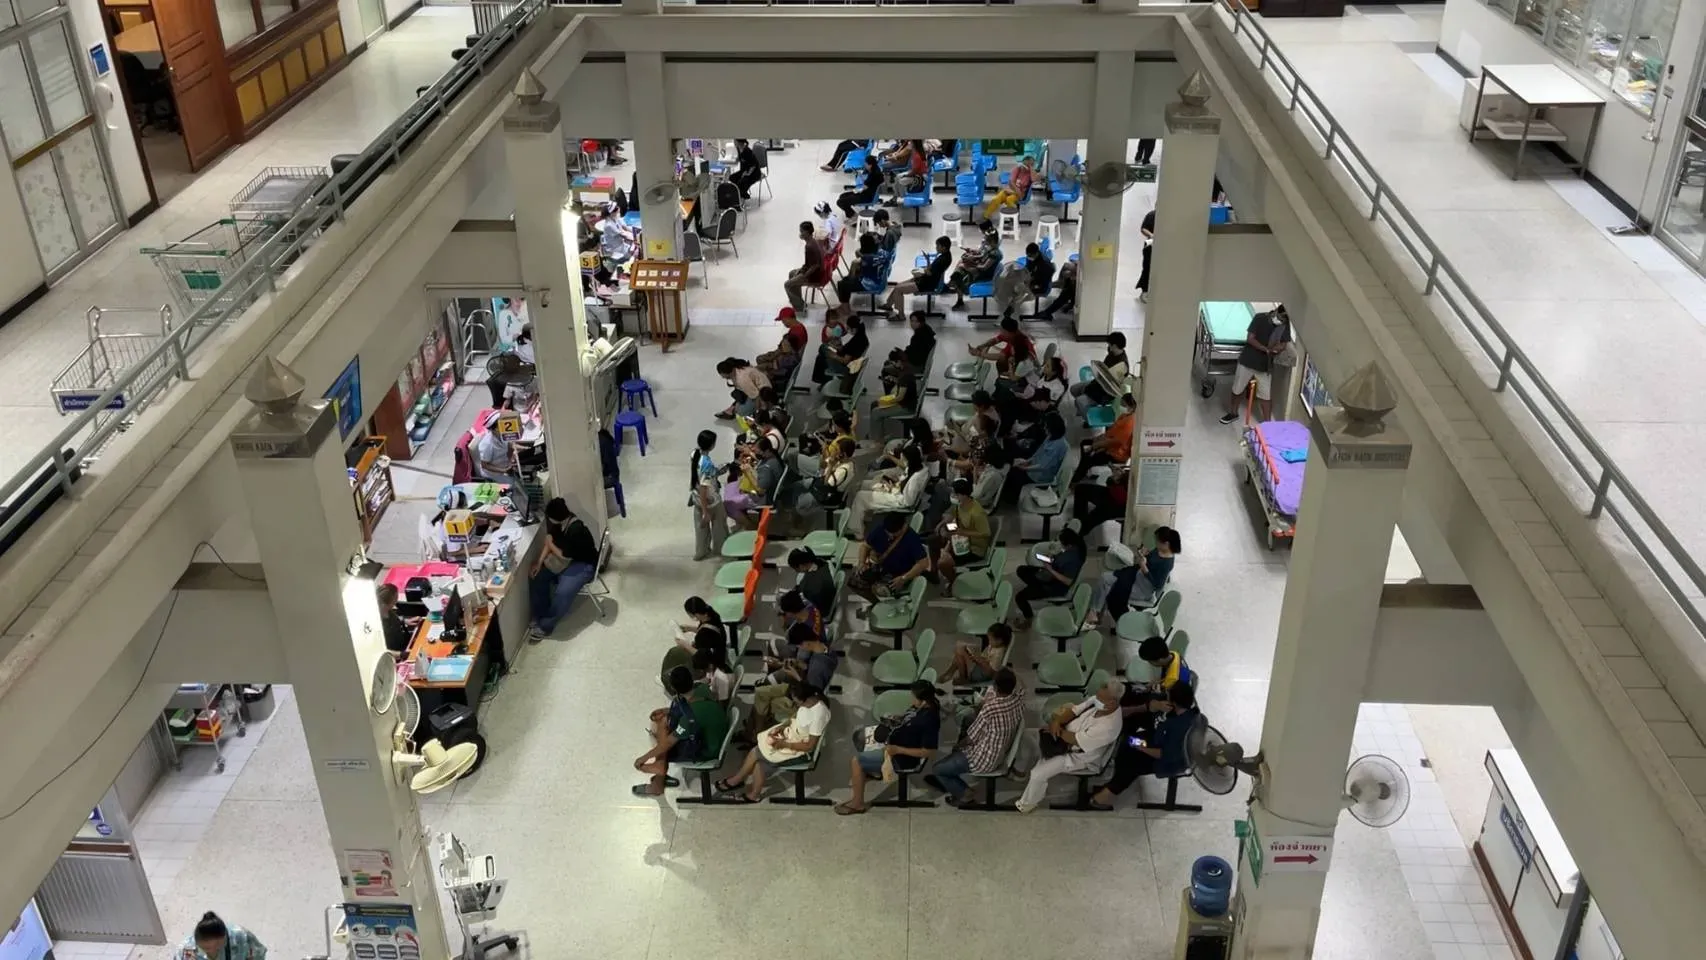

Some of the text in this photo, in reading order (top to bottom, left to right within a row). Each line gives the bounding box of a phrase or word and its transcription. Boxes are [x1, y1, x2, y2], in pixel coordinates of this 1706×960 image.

[504, 421, 513, 432] 2
[1270, 841, 1327, 852] ห้องจ่ายยา
